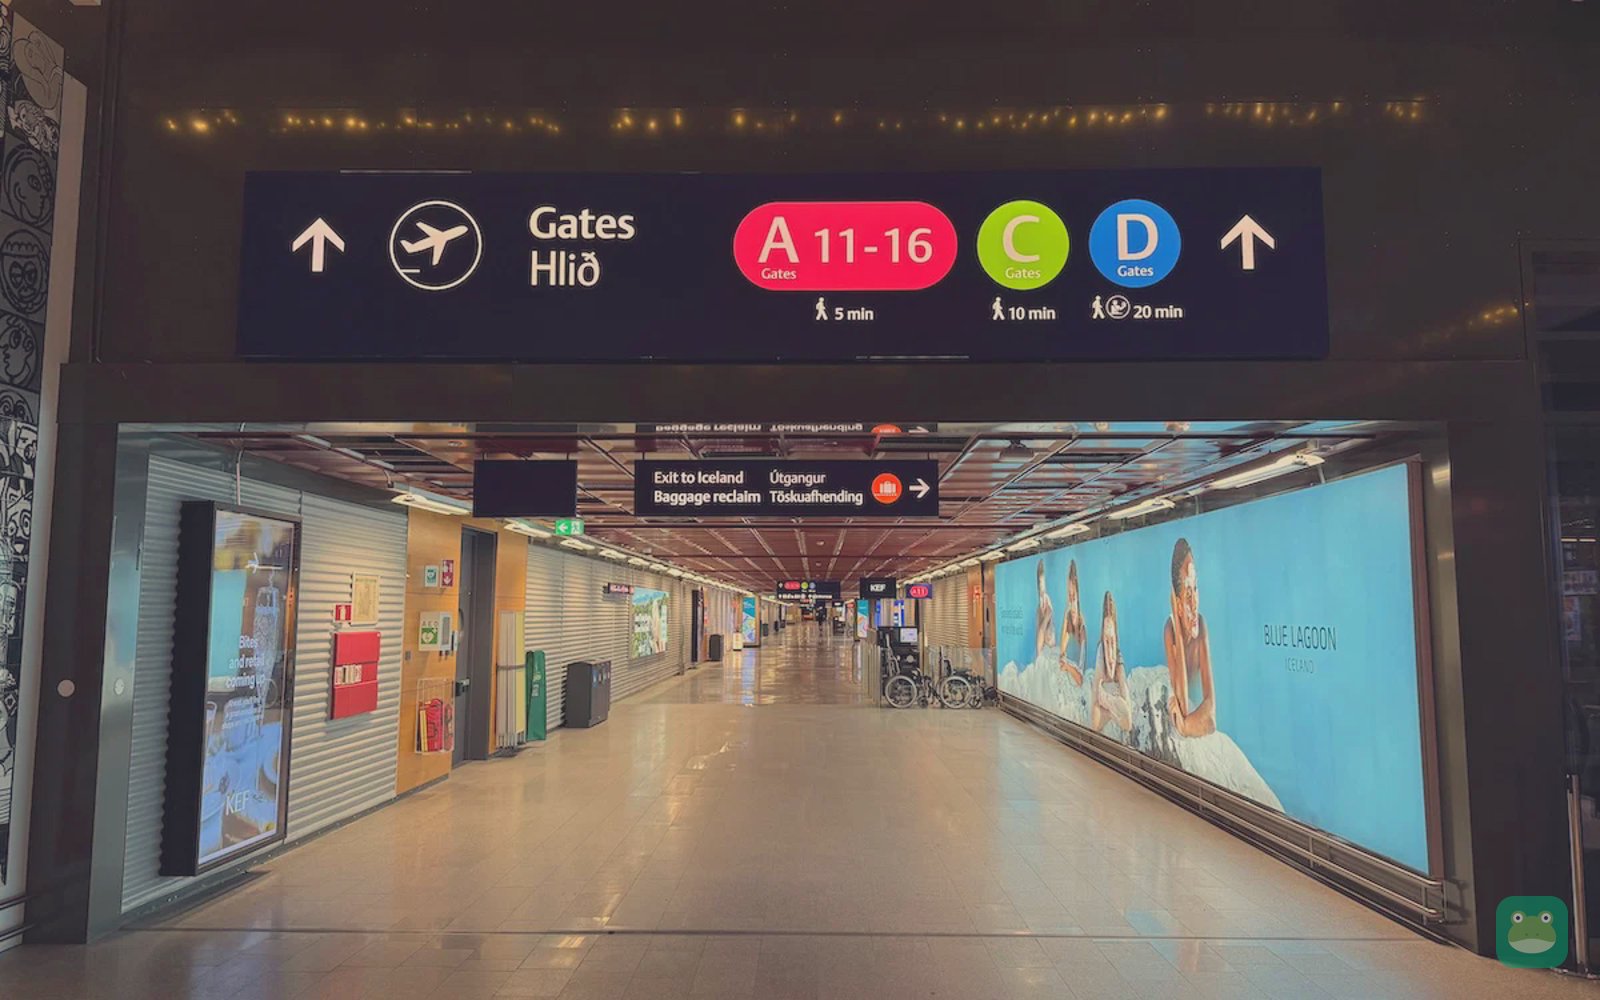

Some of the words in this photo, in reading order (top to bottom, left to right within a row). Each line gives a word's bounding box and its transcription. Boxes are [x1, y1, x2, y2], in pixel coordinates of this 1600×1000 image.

[529, 206, 635, 240] Gates
[757, 215, 800, 264] A
[814, 227, 933, 264] 11-16
[1002, 214, 1041, 263] C
[1116, 213, 1159, 261] D
[530, 250, 601, 287] Hlið
[760, 267, 797, 280] Gates
[1004, 267, 1041, 279] Gates
[1117, 265, 1154, 277] Gates
[834, 307, 844, 321] 5
[847, 307, 874, 321] min
[1008, 306, 1025, 320] 10
[1028, 306, 1056, 320] min
[1133, 304, 1152, 319] 20
[1154, 304, 1183, 319] min
[654, 471, 679, 484] Exit
[680, 471, 695, 485] to
[698, 470, 744, 484] Iceland
[769, 469, 827, 488] Útgangur
[654, 490, 711, 506] Baggage
[713, 490, 762, 504] reclaim
[769, 489, 864, 506] Töskuafhending
[869, 583, 886, 592] KEF
[239, 635, 258, 649] Bites
[1264, 624, 1289, 647] BLUE
[1291, 626, 1337, 651] LAGOON
[229, 654, 245, 669] and
[1284, 657, 1314, 675] ICELAND
[226, 672, 256, 689] coming
[226, 790, 250, 816] KEF
